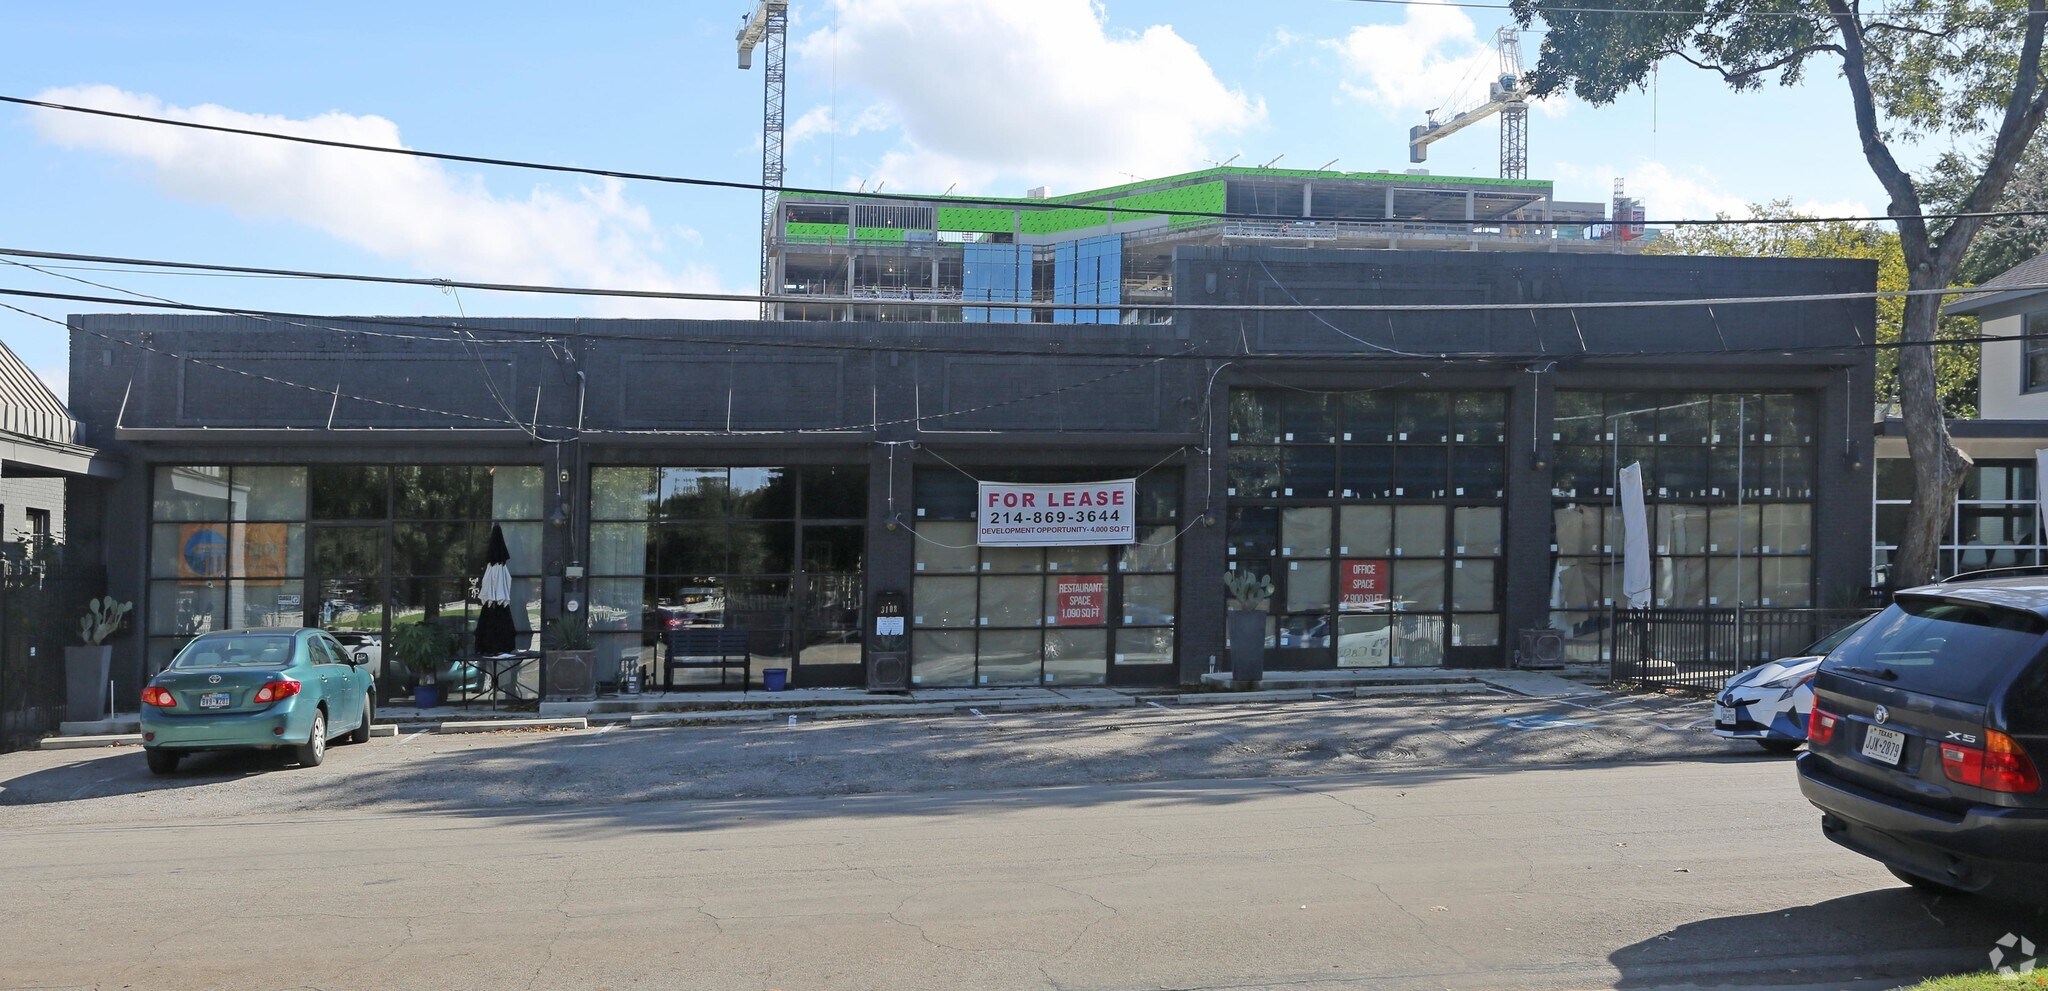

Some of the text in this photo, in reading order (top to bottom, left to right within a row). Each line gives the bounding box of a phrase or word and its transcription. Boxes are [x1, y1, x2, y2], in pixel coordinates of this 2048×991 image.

[988, 490, 1125, 508] FOR LEASE
[990, 509, 1120, 524] 214-869-3644
[1353, 565, 1376, 574] OFFICE
[1058, 583, 1102, 594] RESTAURANT
[1353, 580, 1375, 588] SPACE
[1069, 595, 1092, 606] SPACE
[1344, 594, 1364, 604] 2900
[880, 605, 898, 614] 3108
[1081, 608, 1091, 618] SQ
[1091, 608, 1100, 618] FT
[1878, 729, 1893, 739] TEXAS
[1945, 730, 1977, 743] X5
